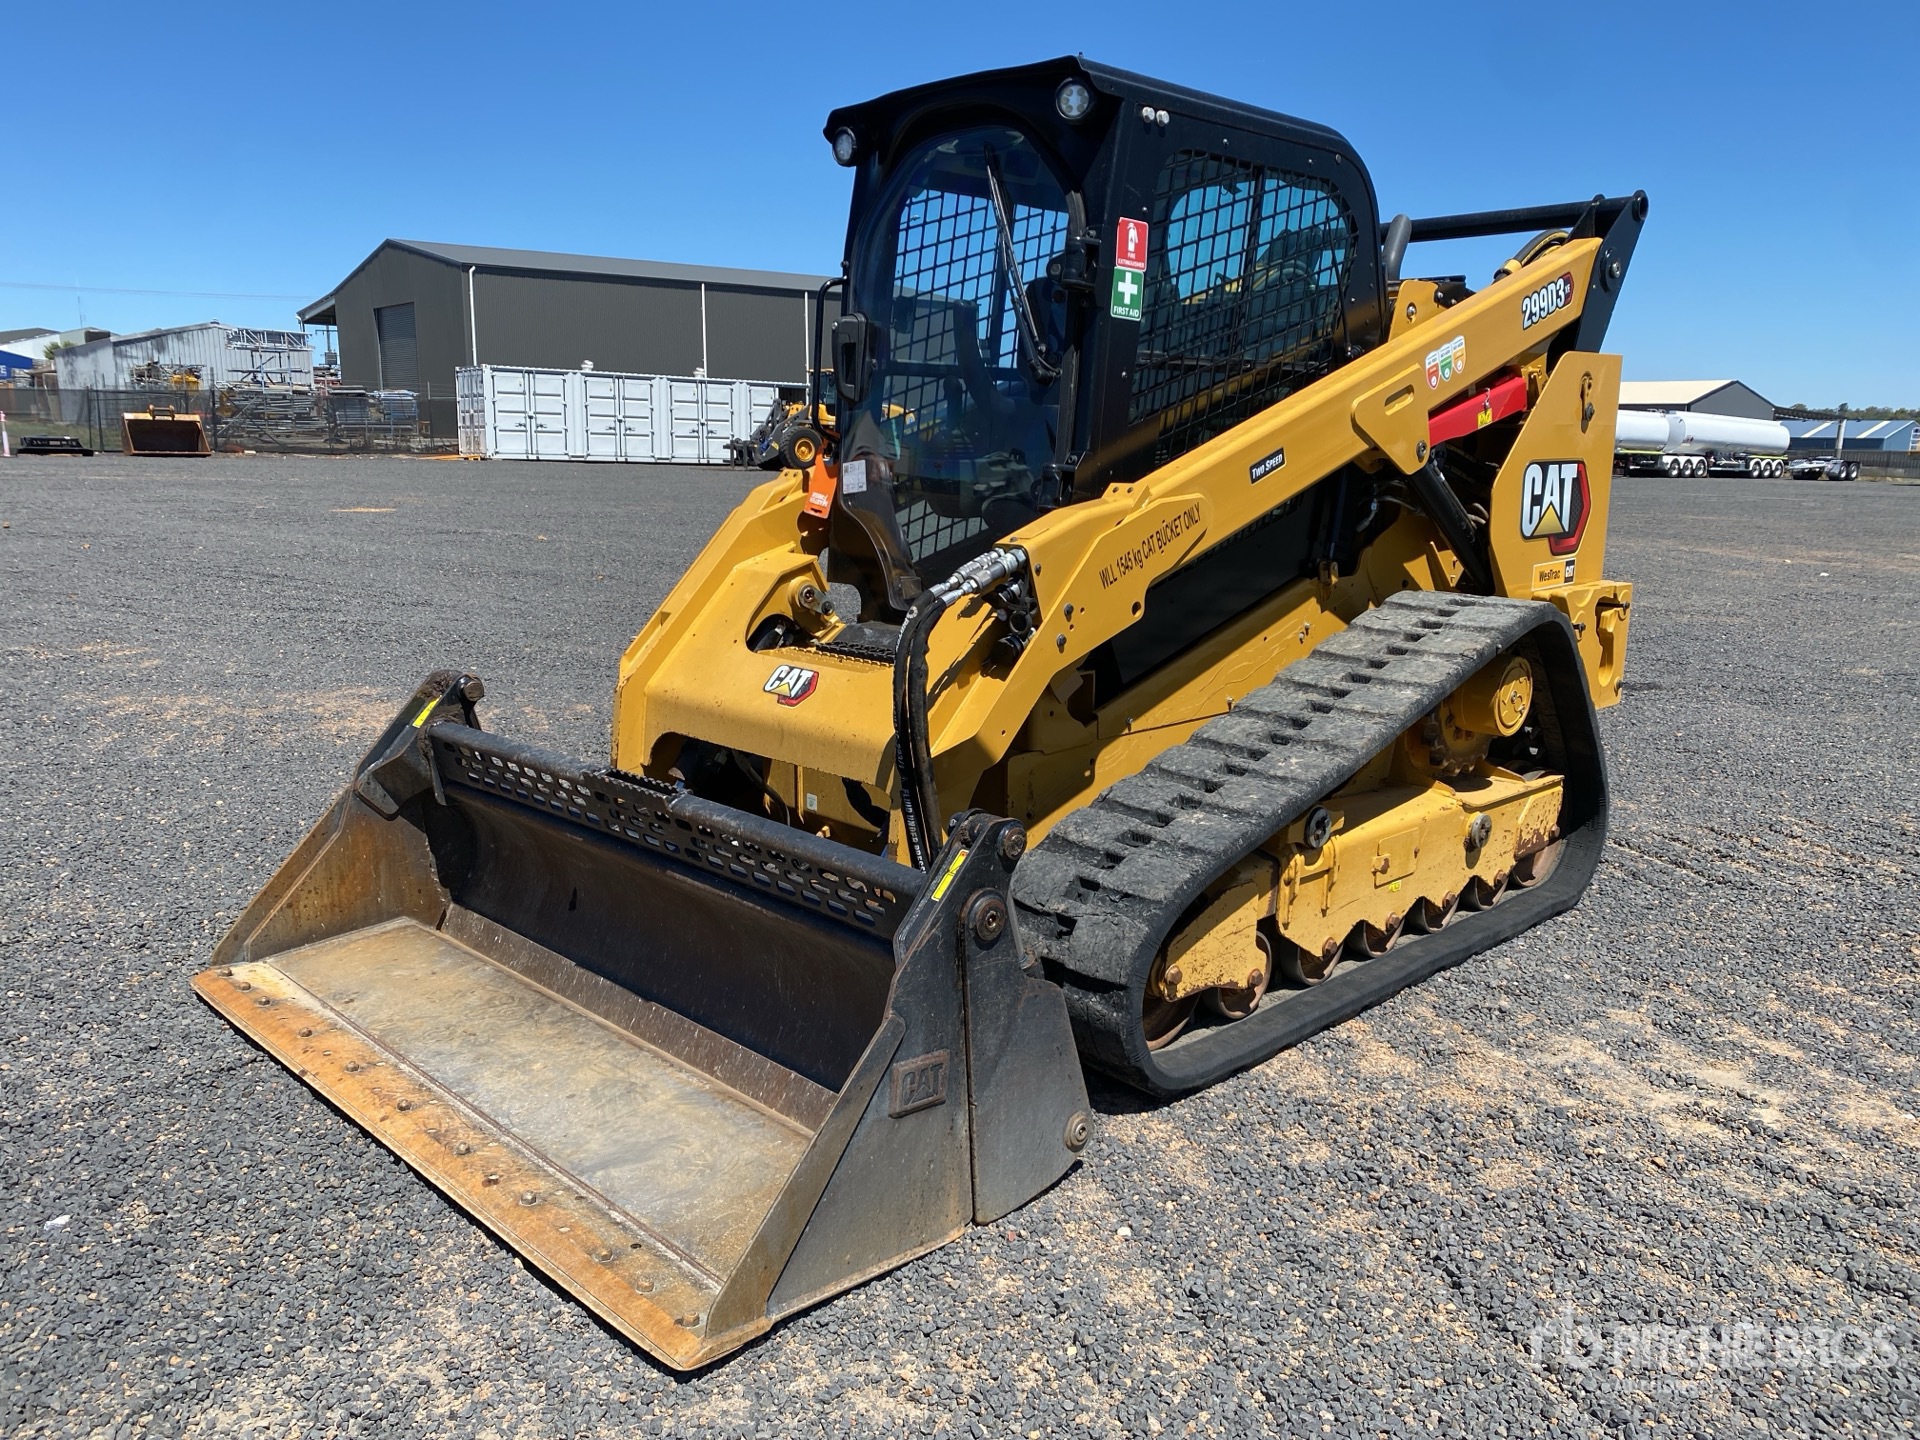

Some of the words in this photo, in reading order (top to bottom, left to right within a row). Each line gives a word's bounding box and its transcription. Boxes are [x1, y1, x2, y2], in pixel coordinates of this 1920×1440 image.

[1113, 305, 1129, 316] FIRST
[1129, 308, 1140, 318] AID
[1522, 277, 1565, 330] 299D3
[1521, 463, 1578, 537] CAT
[1098, 563, 1118, 590] WLL
[1116, 551, 1134, 577] 1545
[1131, 547, 1144, 569] kg
[1141, 534, 1156, 560] CAT
[1155, 514, 1184, 551] BUCKET
[1183, 502, 1201, 531] ONLY
[1539, 569, 1561, 583] WesTrac
[764, 665, 814, 698] CAT
[902, 1062, 944, 1107] CAT
